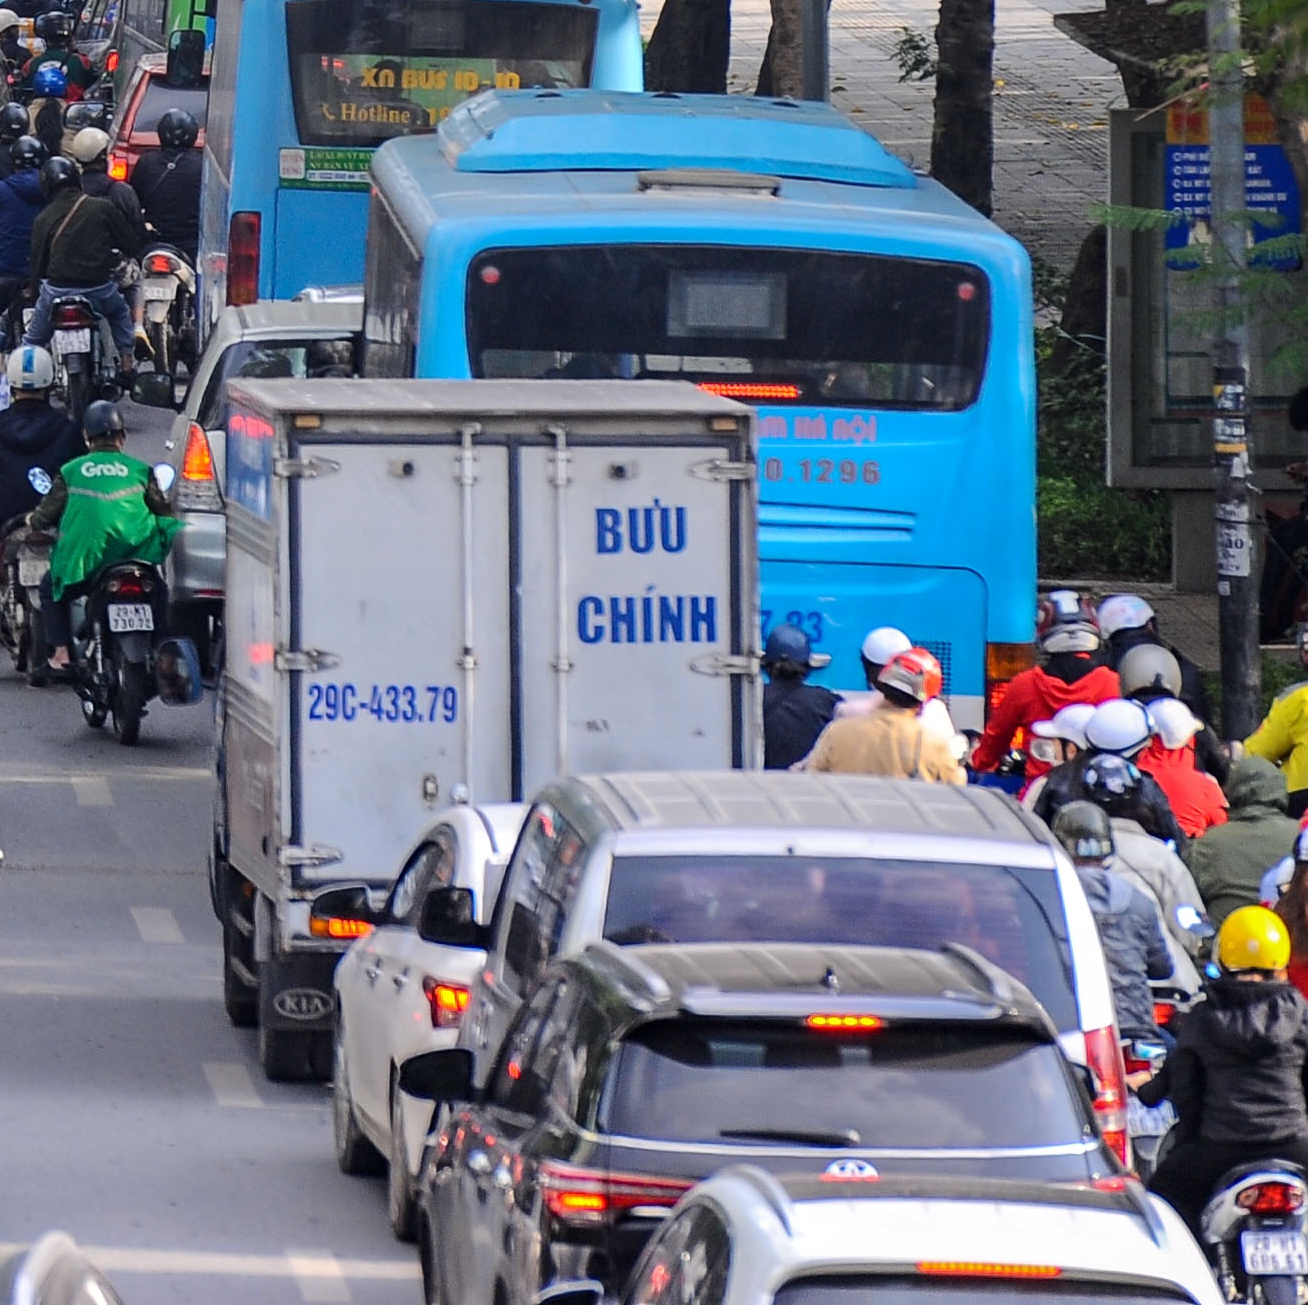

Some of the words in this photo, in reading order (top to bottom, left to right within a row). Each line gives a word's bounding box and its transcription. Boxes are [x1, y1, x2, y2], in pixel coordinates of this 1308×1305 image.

[401, 69, 447, 89] BUS
[341, 102, 411, 124] Hotline
[81, 461, 129, 477] Grab
[765, 457, 881, 485] 0.1296
[595, 498, 687, 555] BƯU
[576, 585, 718, 644] CHÍNH
[308, 683, 458, 723] 29C-433.79
[285, 995, 325, 1015] KIA
